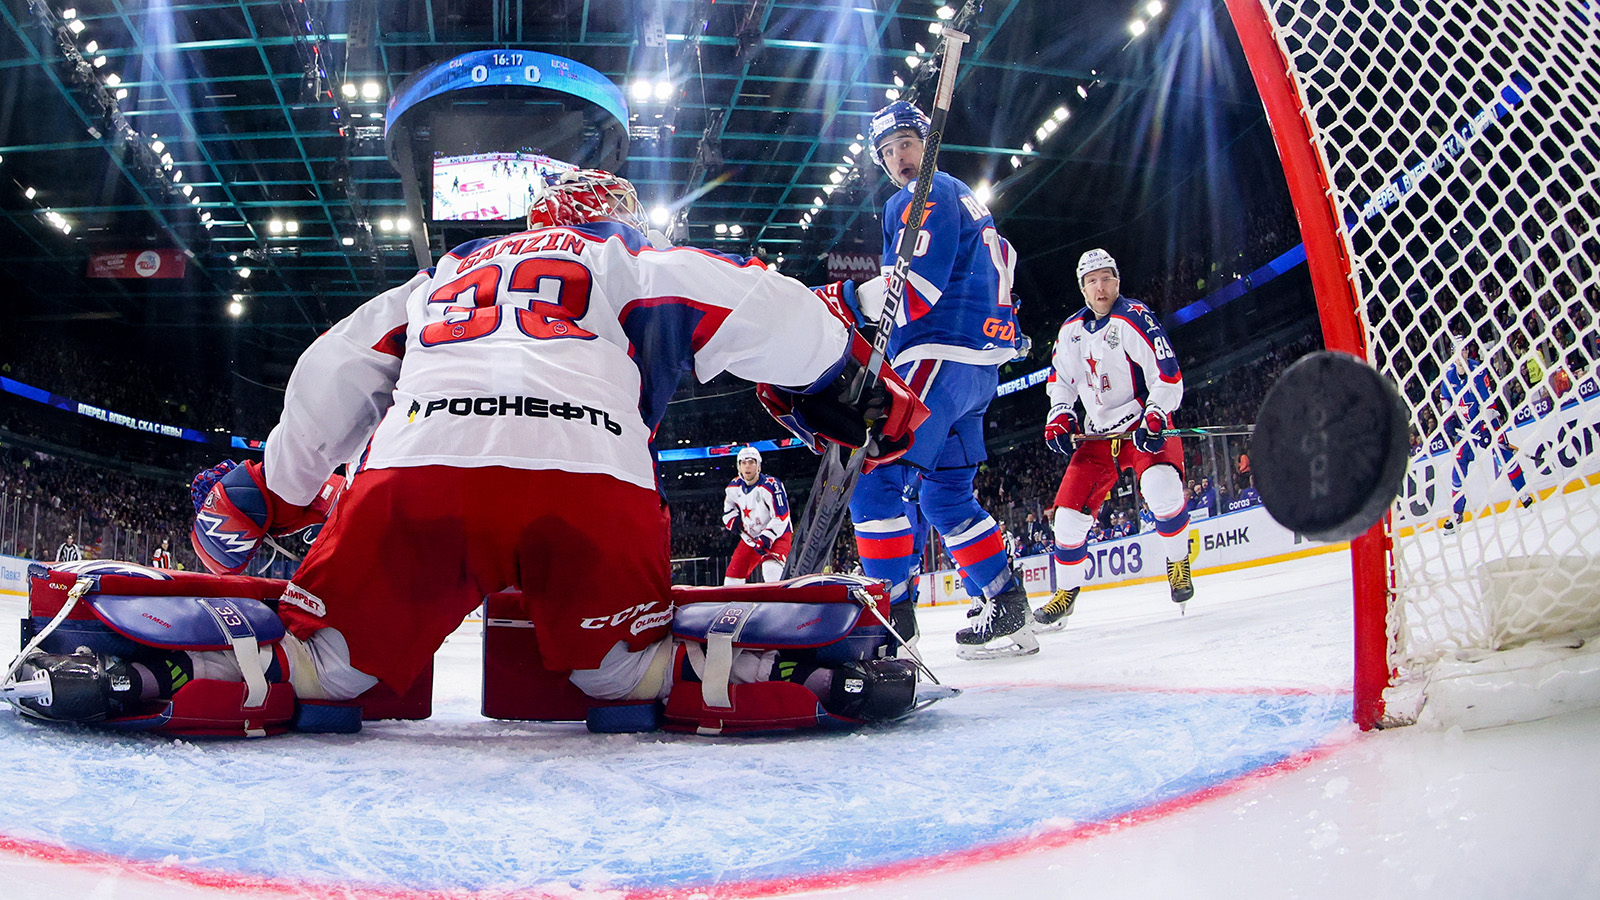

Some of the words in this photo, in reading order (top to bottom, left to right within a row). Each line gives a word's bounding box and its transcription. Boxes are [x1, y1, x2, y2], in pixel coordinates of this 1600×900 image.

[493, 54, 524, 66] 16:17
[471, 65, 488, 83] 0
[524, 65, 541, 83] 0
[456, 232, 586, 275] GAMZIN
[419, 256, 599, 348] 33
[996, 376, 1029, 397] ВПЕРЕД,
[77, 402, 108, 422] ВПЕРЕД,
[108, 411, 138, 430] ВПЕРЕД,
[138, 419, 154, 433] СКА
[160, 425, 183, 439] НЕВЫ
[424, 395, 622, 437] РОСНЕФТЬ
[1204, 526, 1250, 551] БАНК
[1084, 542, 1143, 581] огаз
[282, 589, 320, 611] LIMPBET
[141, 612, 171, 629] GAMZIN
[214, 606, 241, 627] 33
[580, 601, 659, 629] CCM
